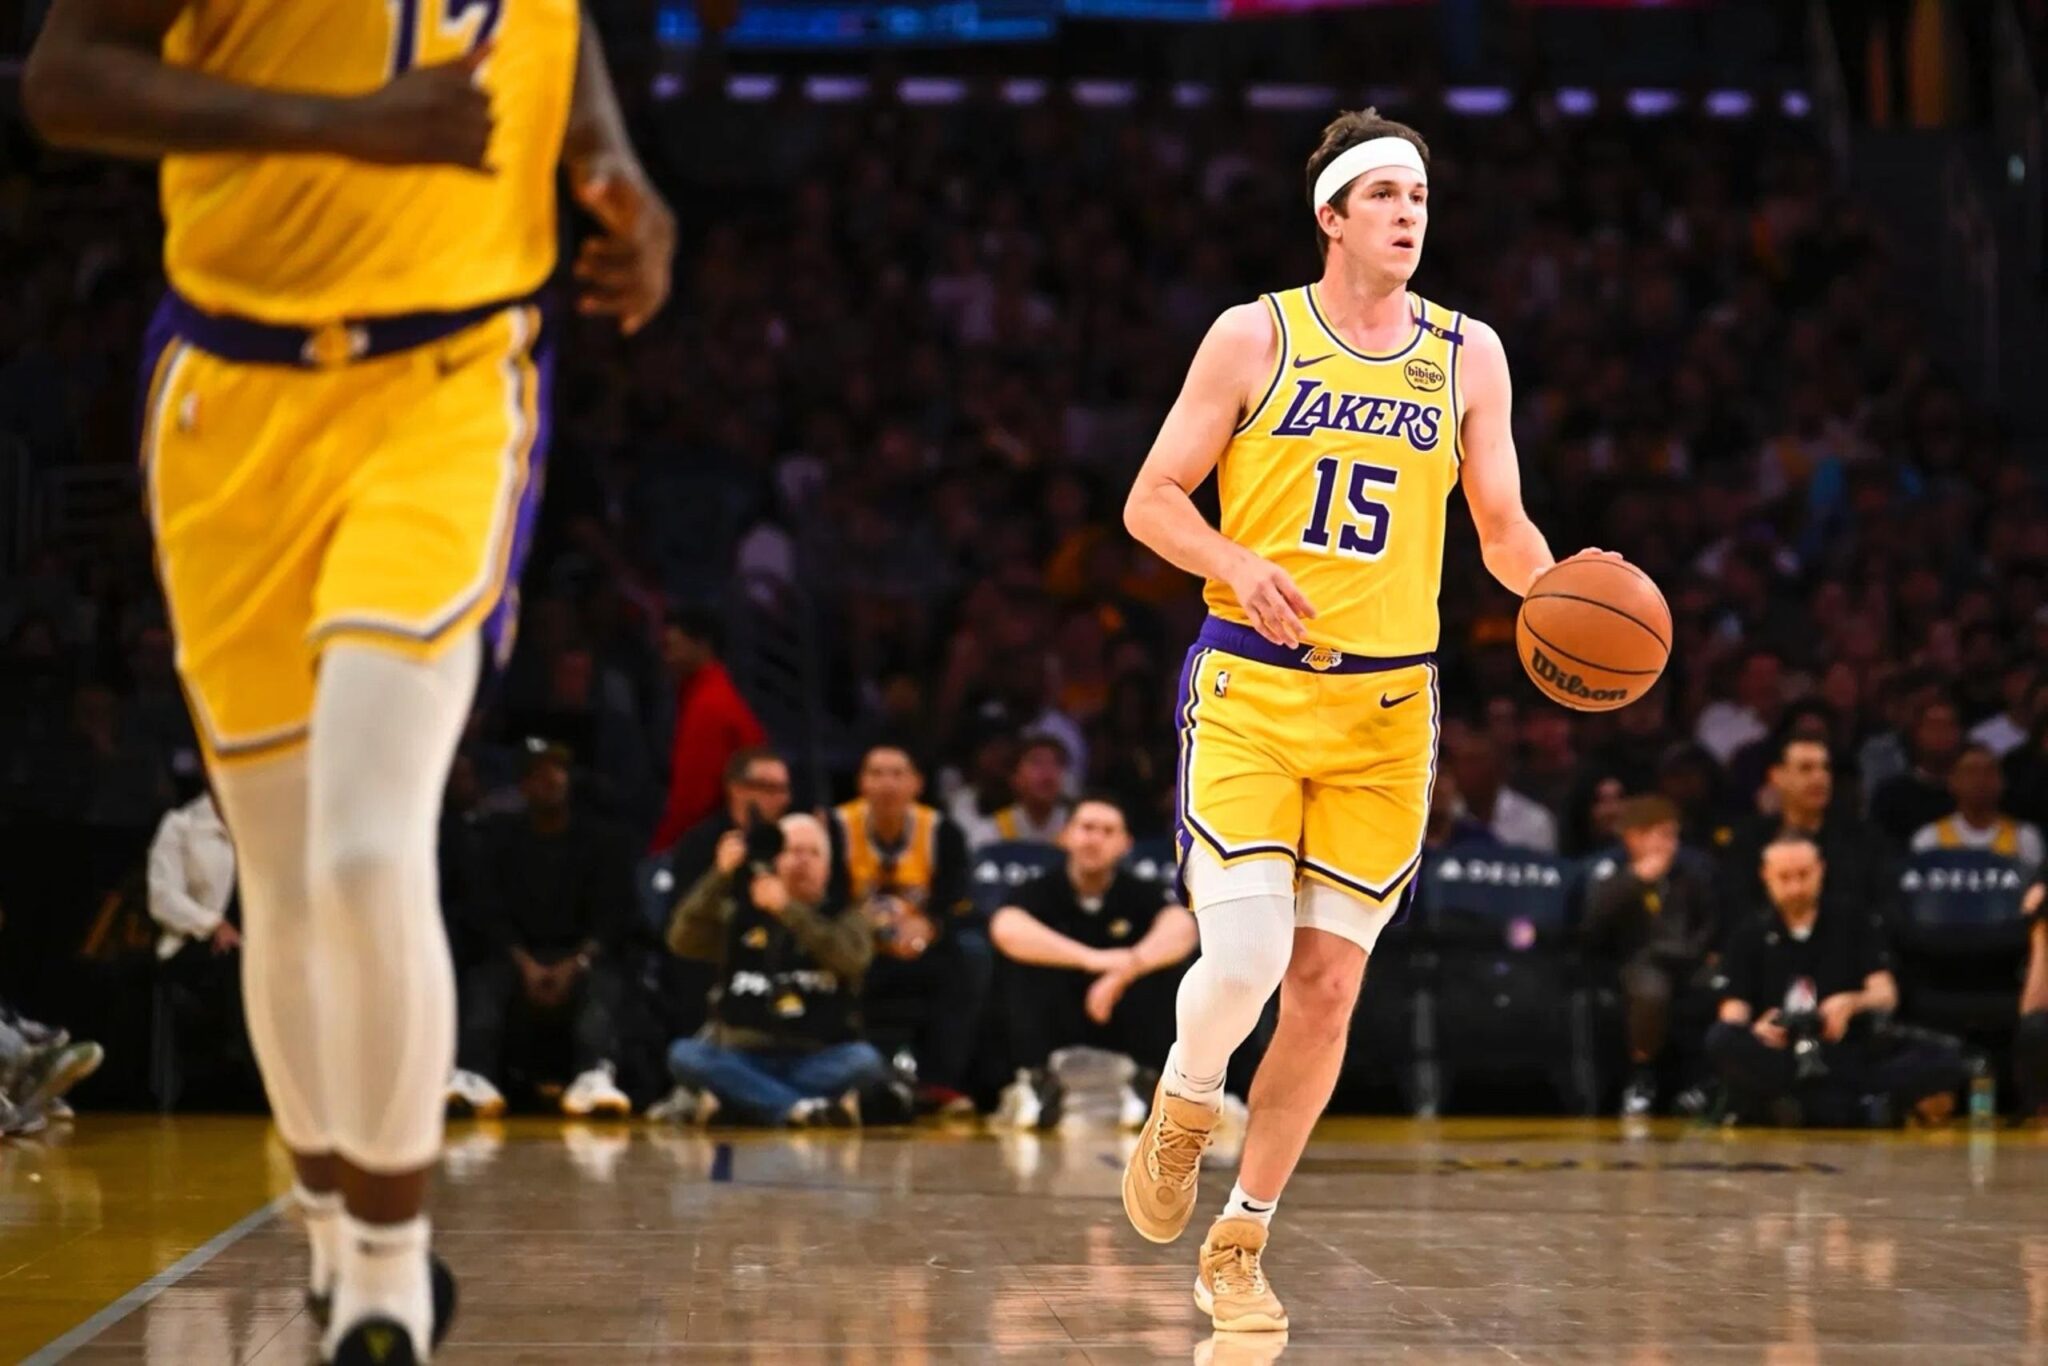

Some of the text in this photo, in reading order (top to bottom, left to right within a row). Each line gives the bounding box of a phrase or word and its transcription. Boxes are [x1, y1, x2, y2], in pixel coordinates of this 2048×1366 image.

[1407, 366, 1443, 384] bibigo
[1270, 379, 1443, 452] LAKERS
[1301, 456, 1398, 558] 15
[1531, 646, 1628, 701] Wilson
[1466, 859, 1562, 887] DELTA
[1926, 867, 2021, 892] DELTA
